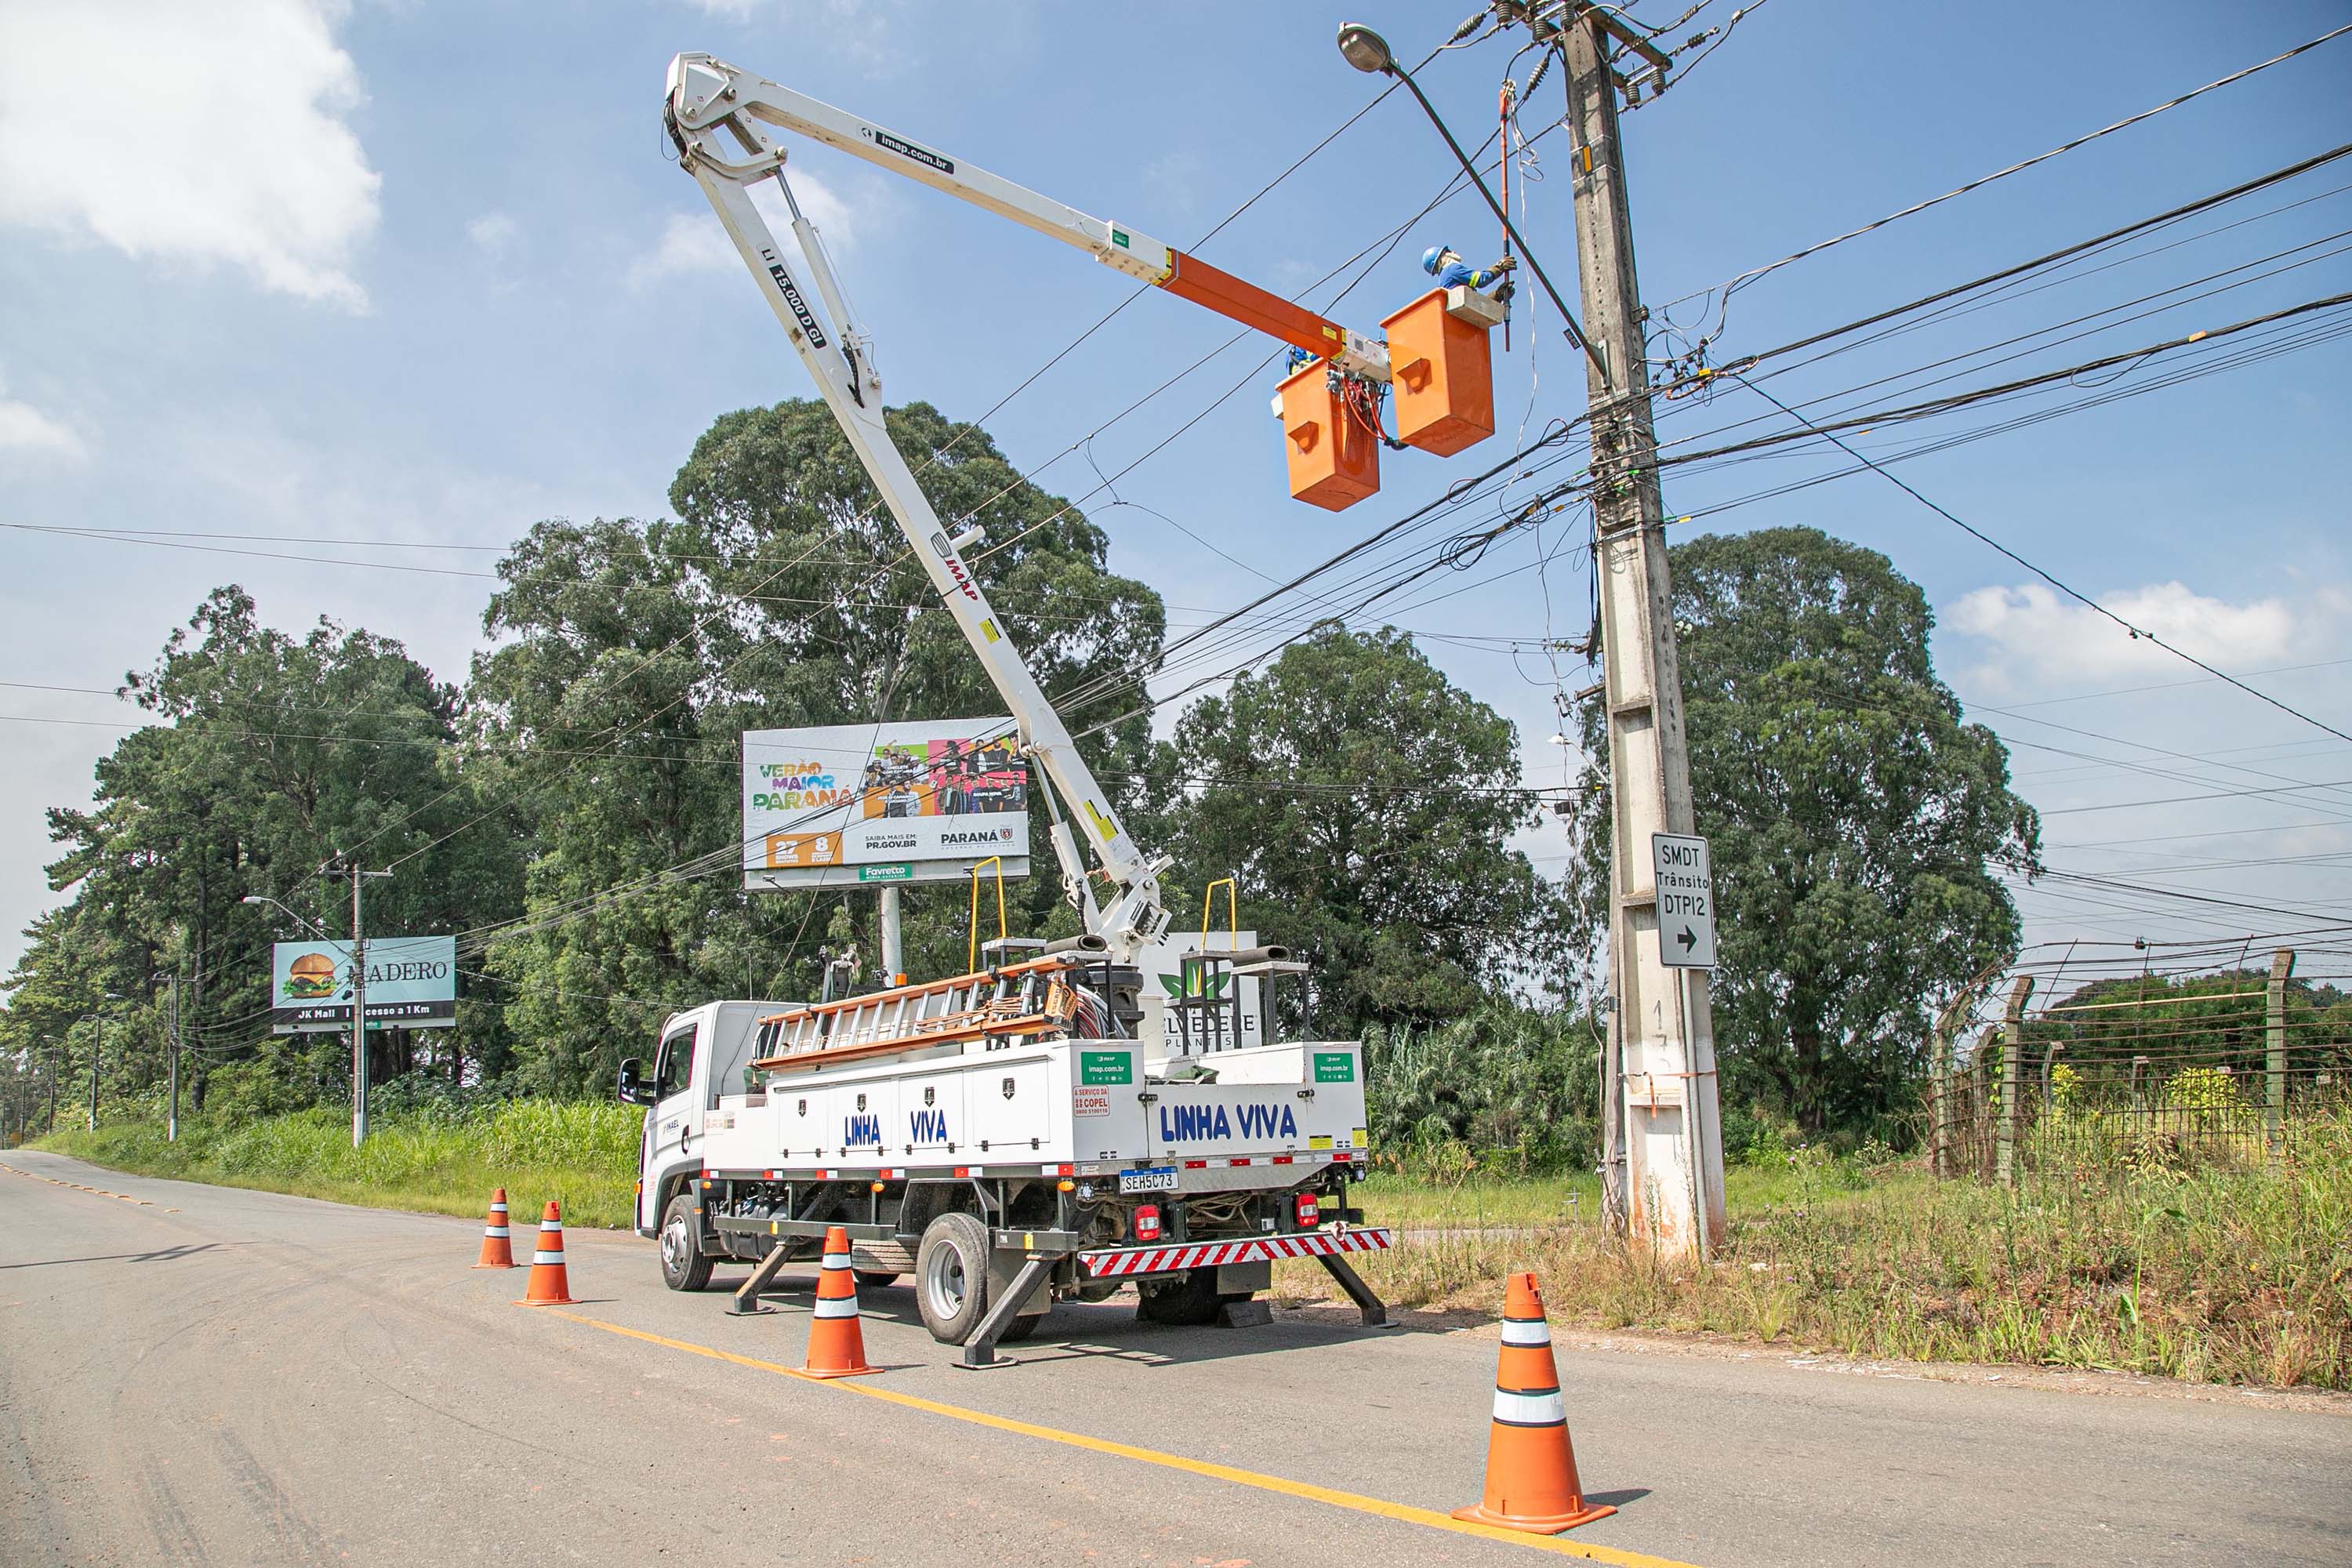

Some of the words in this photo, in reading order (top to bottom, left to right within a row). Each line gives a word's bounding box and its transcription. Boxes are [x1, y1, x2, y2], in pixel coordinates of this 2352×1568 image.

[882, 135, 947, 169] imap.com.br
[761, 249, 775, 261] LI
[775, 270, 806, 314] 15.000
[800, 315, 812, 326] D
[808, 328, 823, 343] GI
[945, 559, 978, 601] IMAP
[760, 760, 822, 778] VERÃO
[772, 775, 835, 790] MAIOR
[753, 785, 855, 811] PARANÁ
[815, 837, 829, 851] 8
[866, 840, 916, 849] PR.GOV.BR
[941, 829, 999, 844] PARANÁ
[775, 840, 798, 855] 27
[1662, 844, 1699, 867] SMDT
[1657, 871, 1708, 889] Trânsito
[298, 1011, 312, 1019] JK
[314, 1009, 336, 1018] Mall
[365, 1007, 395, 1016] cesso
[414, 1005, 430, 1014] Km
[1088, 1065, 1124, 1073] imap.com.br
[1084, 1098, 1108, 1108] COPEL
[845, 1114, 880, 1146] LINHA
[910, 1109, 947, 1143] VIVA
[1160, 1104, 1231, 1142] LINHA
[1236, 1104, 1298, 1139] VIVA
[1126, 1174, 1172, 1190] SEH5C73
